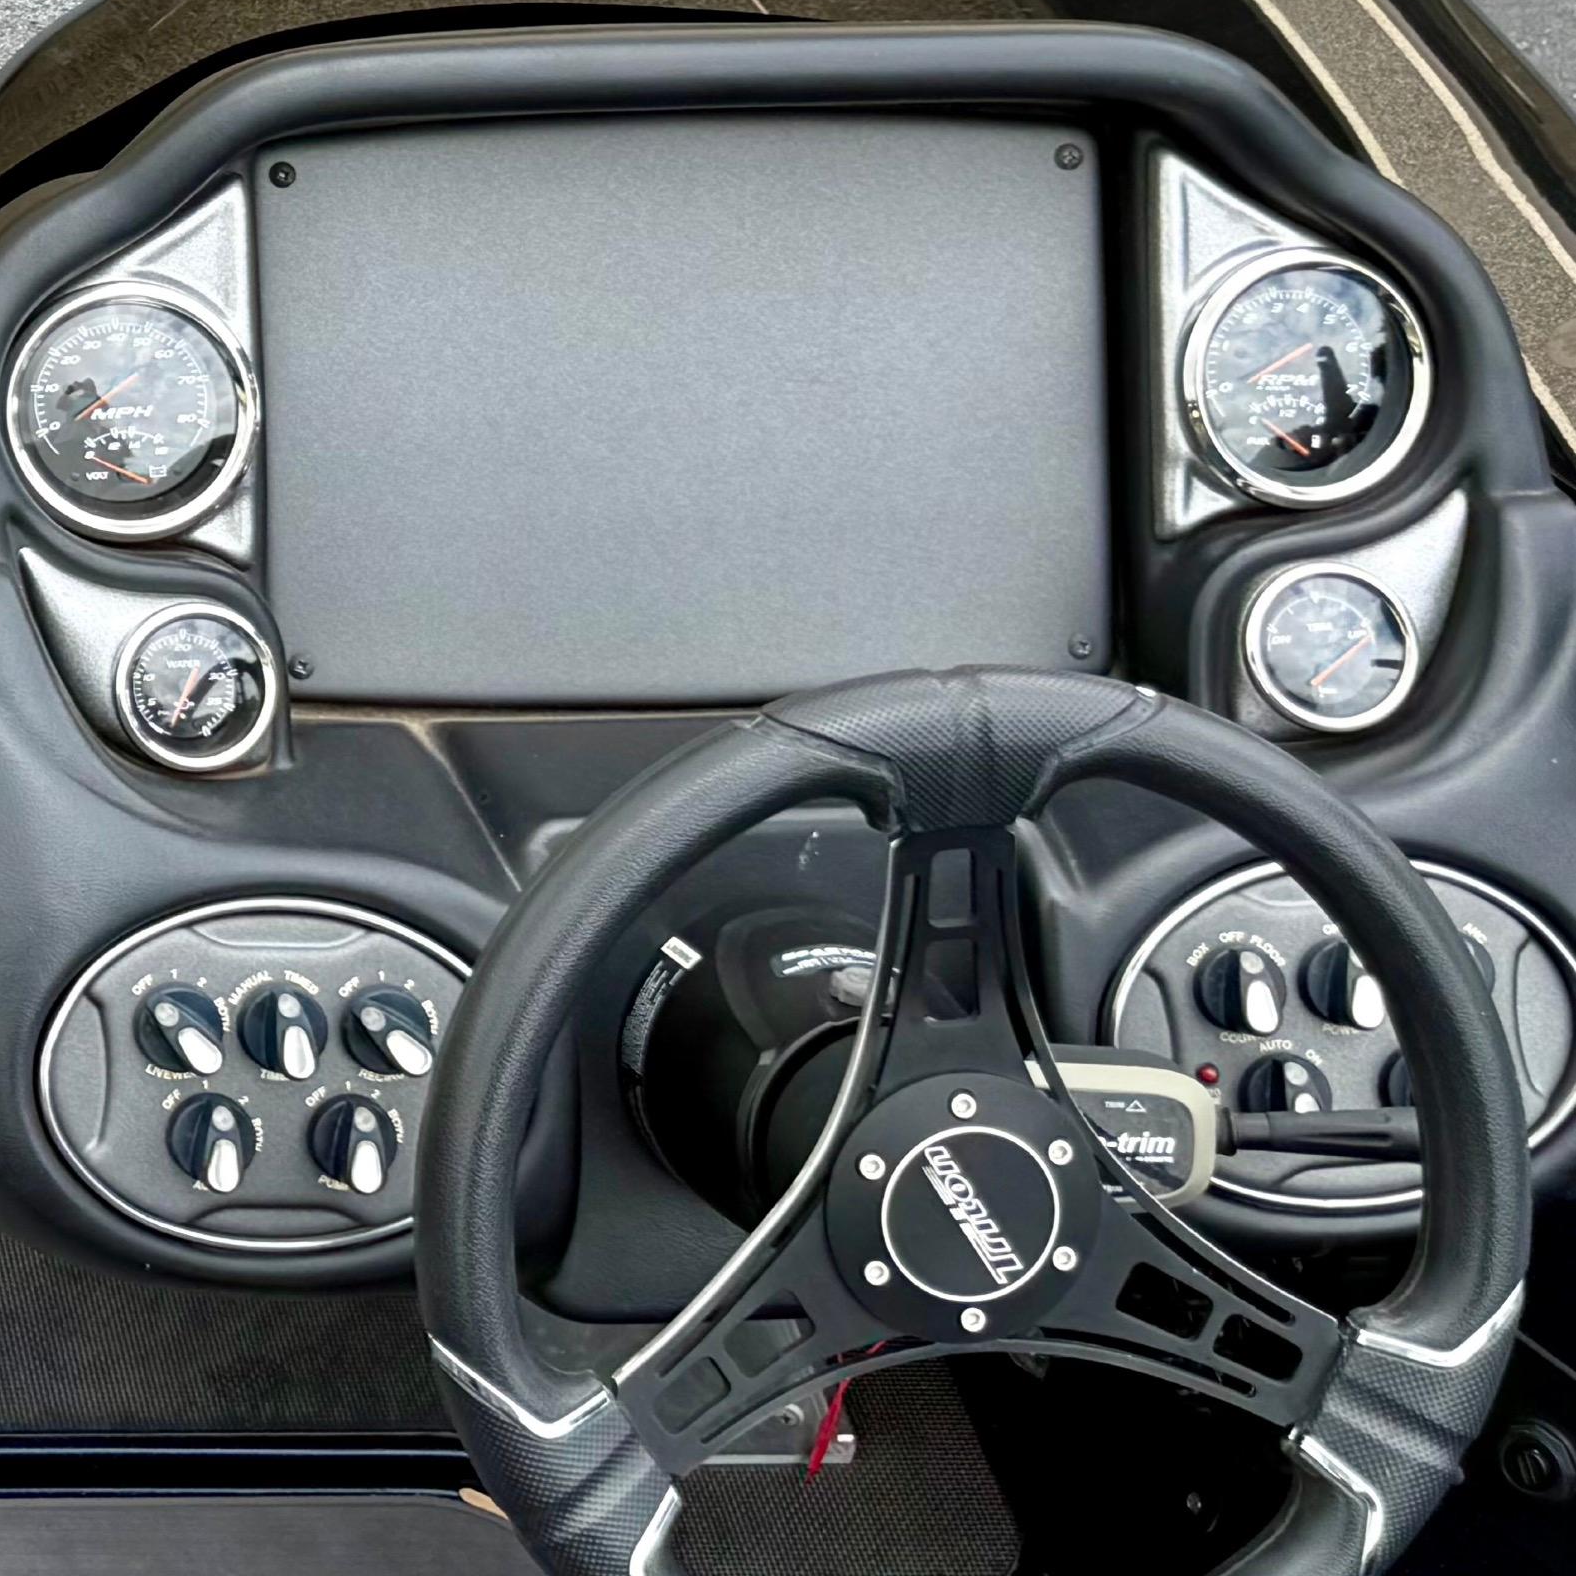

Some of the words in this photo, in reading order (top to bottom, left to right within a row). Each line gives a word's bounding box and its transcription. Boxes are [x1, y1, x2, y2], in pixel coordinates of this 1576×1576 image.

[1271, 303, 1283, 313] 3
[1296, 303, 1309, 313] 4
[1323, 315, 1338, 325] 5
[1345, 343, 1359, 353] 6
[155, 349, 174, 359] 60
[178, 375, 196, 385] 70
[1258, 374, 1320, 386] RPM
[1219, 383, 1234, 393] 0
[91, 405, 154, 421] MPH
[49, 421, 61, 430] 0
[1219, 931, 1245, 943] OFF
[1186, 942, 1210, 967] BOX
[1249, 934, 1286, 967] FLOOR
[170, 969, 178, 980] 1
[378, 970, 385, 981] 1
[131, 974, 153, 996] OFF
[228, 970, 273, 1005] MANUAL
[338, 976, 360, 997] OFF
[1259, 1039, 1293, 1052] AUTO
[1305, 1049, 1323, 1065] ON
[202, 1079, 208, 1089] 1
[345, 1080, 351, 1091] 1
[162, 1088, 181, 1109] OFF
[305, 1086, 326, 1107] OFF
[371, 1089, 381, 1099] 2
[922, 1144, 1025, 1286] Triton
